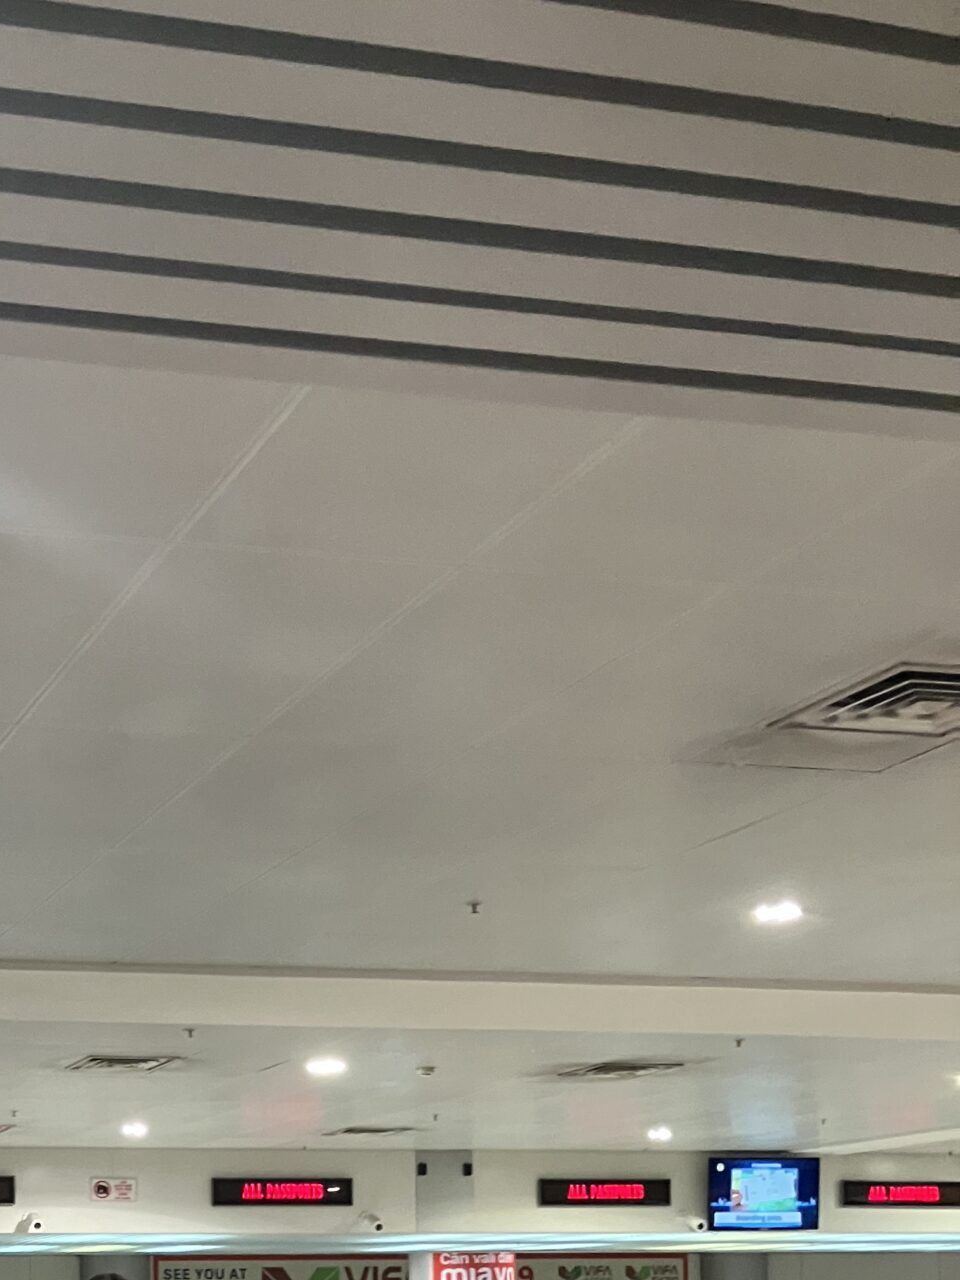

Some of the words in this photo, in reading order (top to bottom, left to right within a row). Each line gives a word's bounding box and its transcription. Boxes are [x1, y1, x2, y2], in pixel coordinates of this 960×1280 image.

[242, 1183, 264, 1199] ALL
[266, 1183, 324, 1199] PASSPORTS
[567, 1184, 589, 1199] ALL
[163, 1268, 190, 1280] SEE
[195, 1268, 225, 1280] YOU
[230, 1268, 247, 1280] AT
